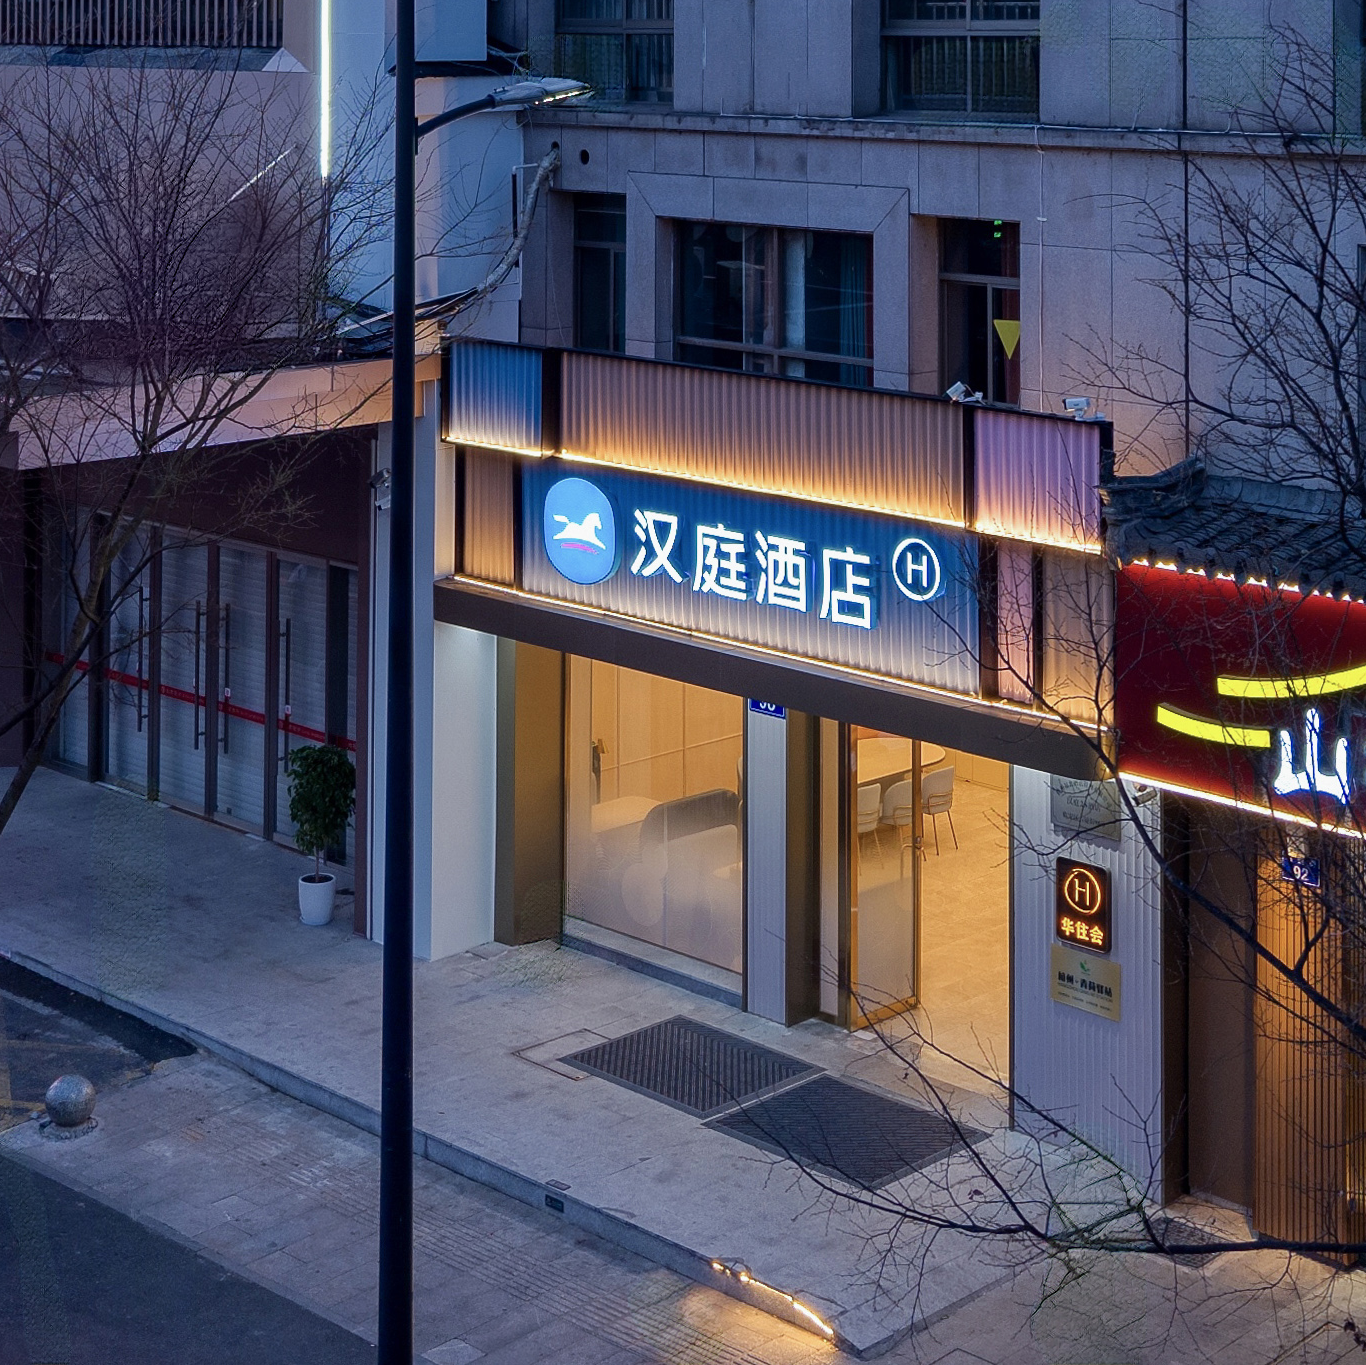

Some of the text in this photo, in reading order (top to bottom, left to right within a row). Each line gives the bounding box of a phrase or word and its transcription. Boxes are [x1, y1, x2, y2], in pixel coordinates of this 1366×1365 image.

[631, 509, 873, 629] 汉庭酒店
[1293, 865, 1309, 881] 92
[1060, 916, 1105, 946] 华住会
